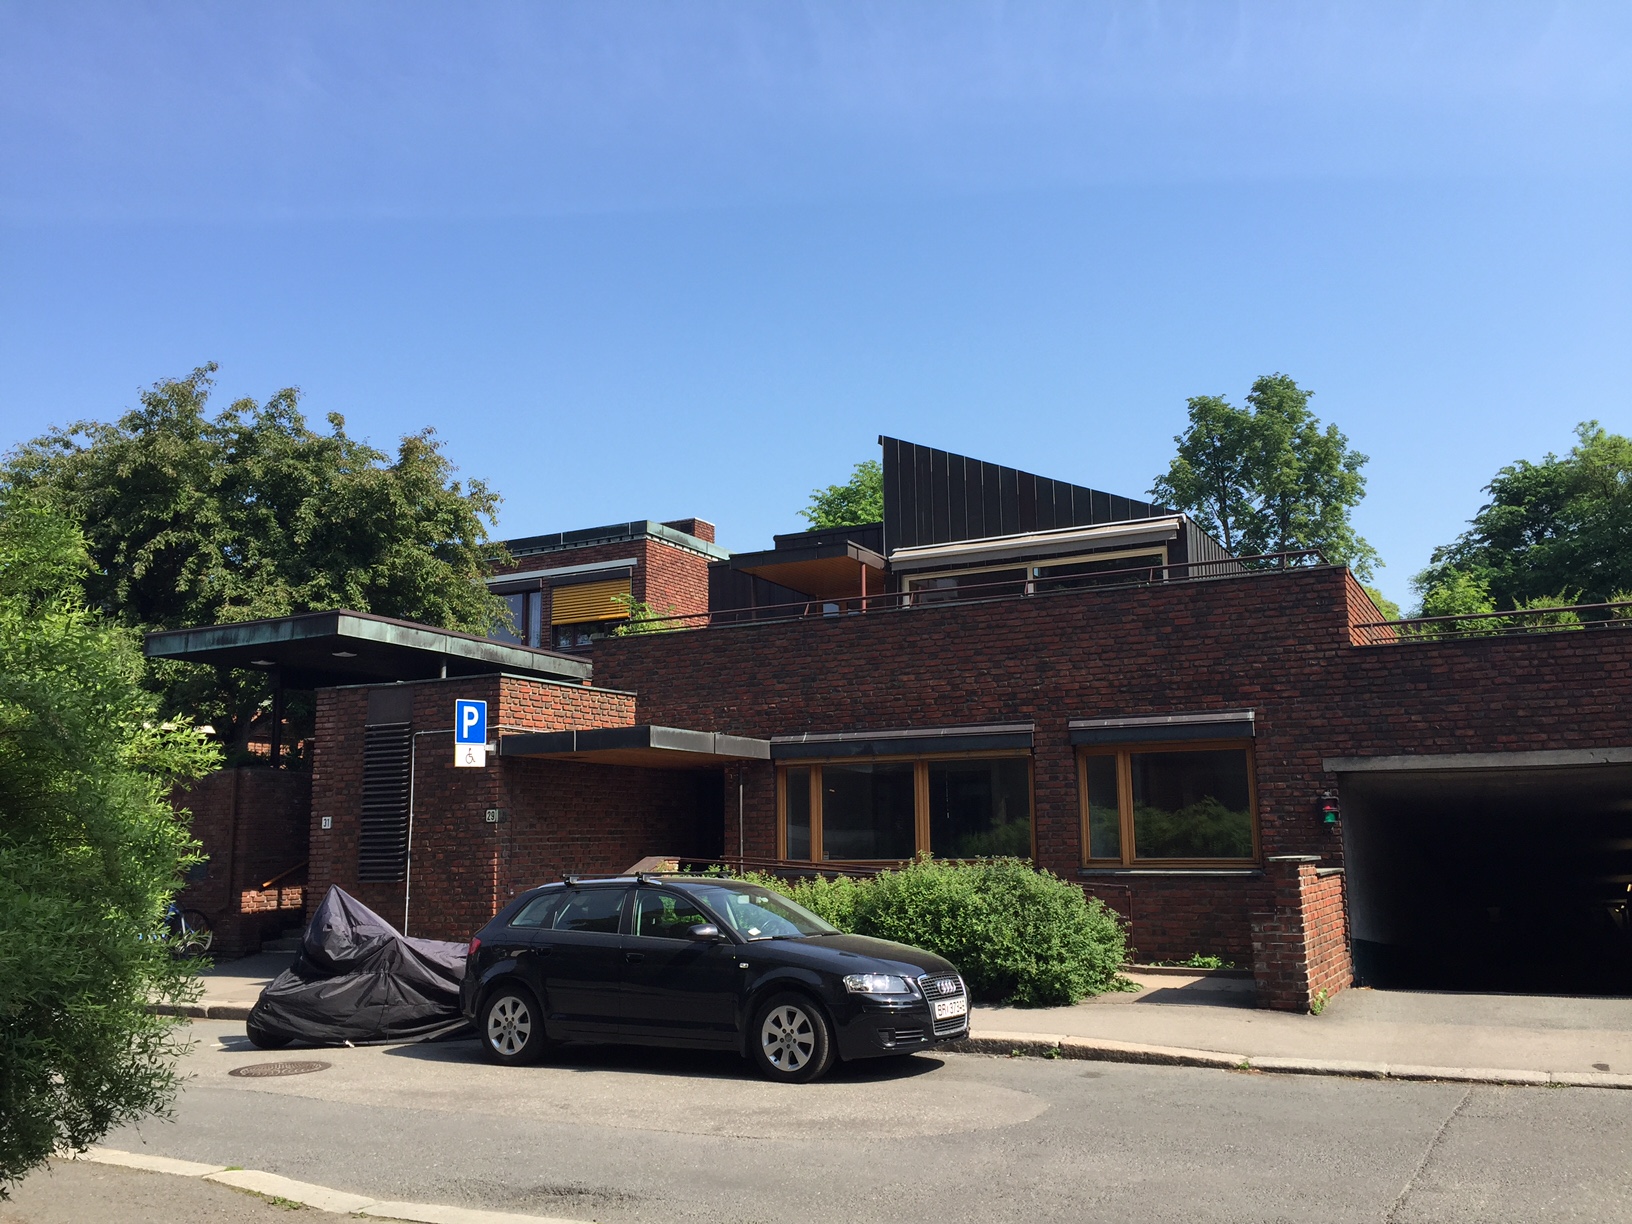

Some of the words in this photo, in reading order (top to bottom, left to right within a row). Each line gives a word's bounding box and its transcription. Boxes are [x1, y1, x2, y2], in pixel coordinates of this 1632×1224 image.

[463, 706, 479, 738] P
[487, 811, 495, 821] 29
[323, 818, 330, 828] 31
